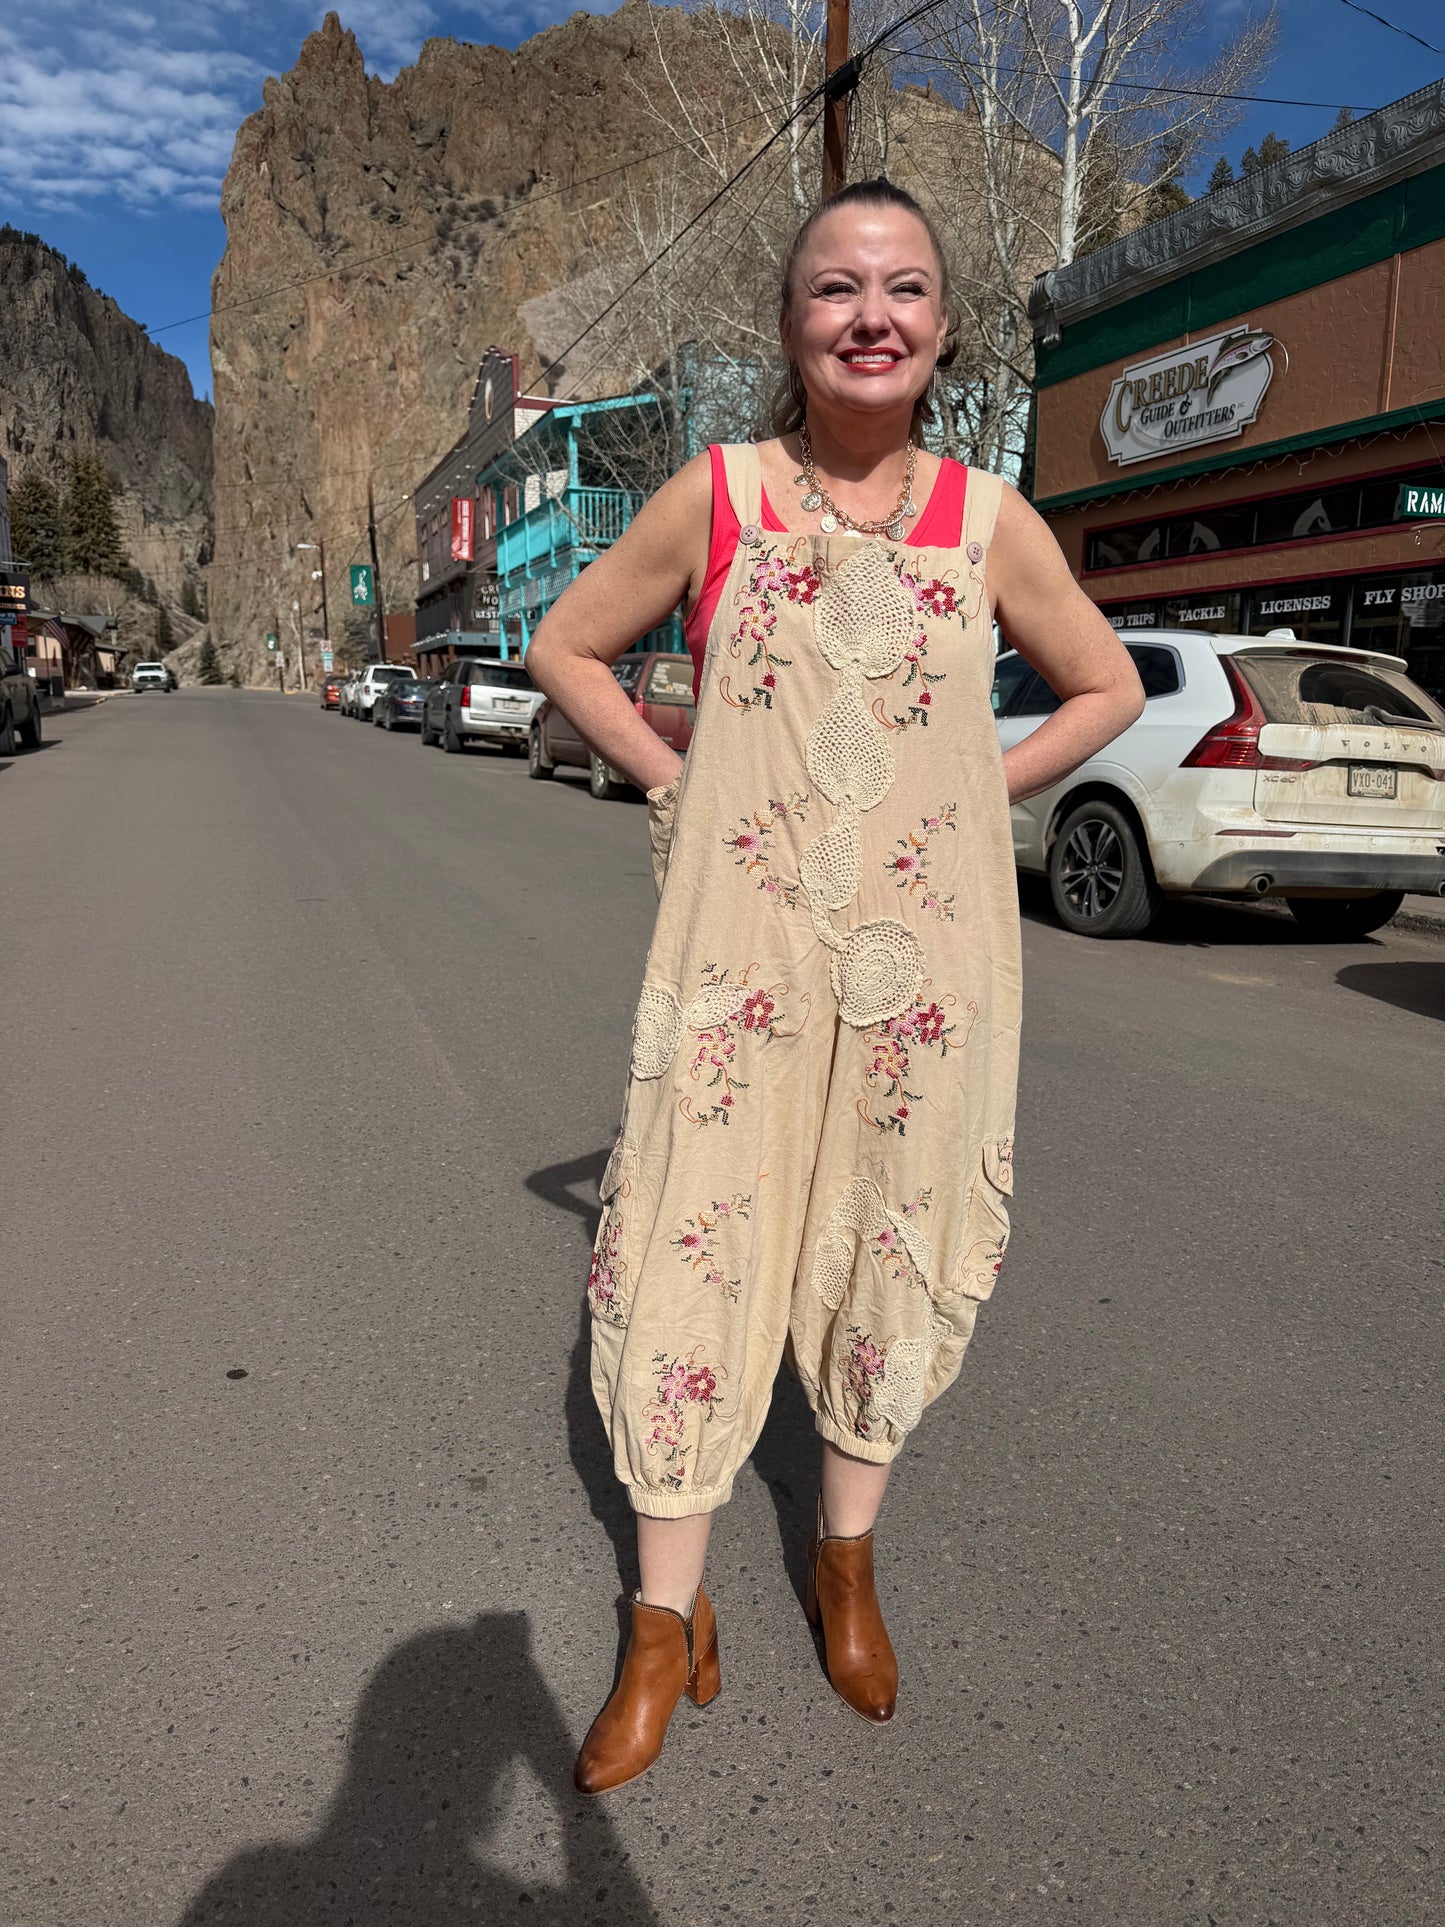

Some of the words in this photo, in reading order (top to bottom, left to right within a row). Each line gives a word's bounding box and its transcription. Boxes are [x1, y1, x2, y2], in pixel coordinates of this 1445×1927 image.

[1116, 355, 1209, 433] CREEDE
[1140, 402, 1175, 425] GUIDE
[1179, 394, 1193, 415] &
[1164, 404, 1236, 438] OUTFITTERS
[1406, 490, 1445, 515] RAM
[0, 586, 26, 598] INS
[1364, 588, 1396, 606] FLY
[1401, 584, 1445, 602] SHOP
[1178, 605, 1225, 623] TACKLE
[1260, 595, 1331, 615] LICENSES
[1126, 612, 1155, 627] TRIPS
[1341, 739, 1427, 753] VOLVO
